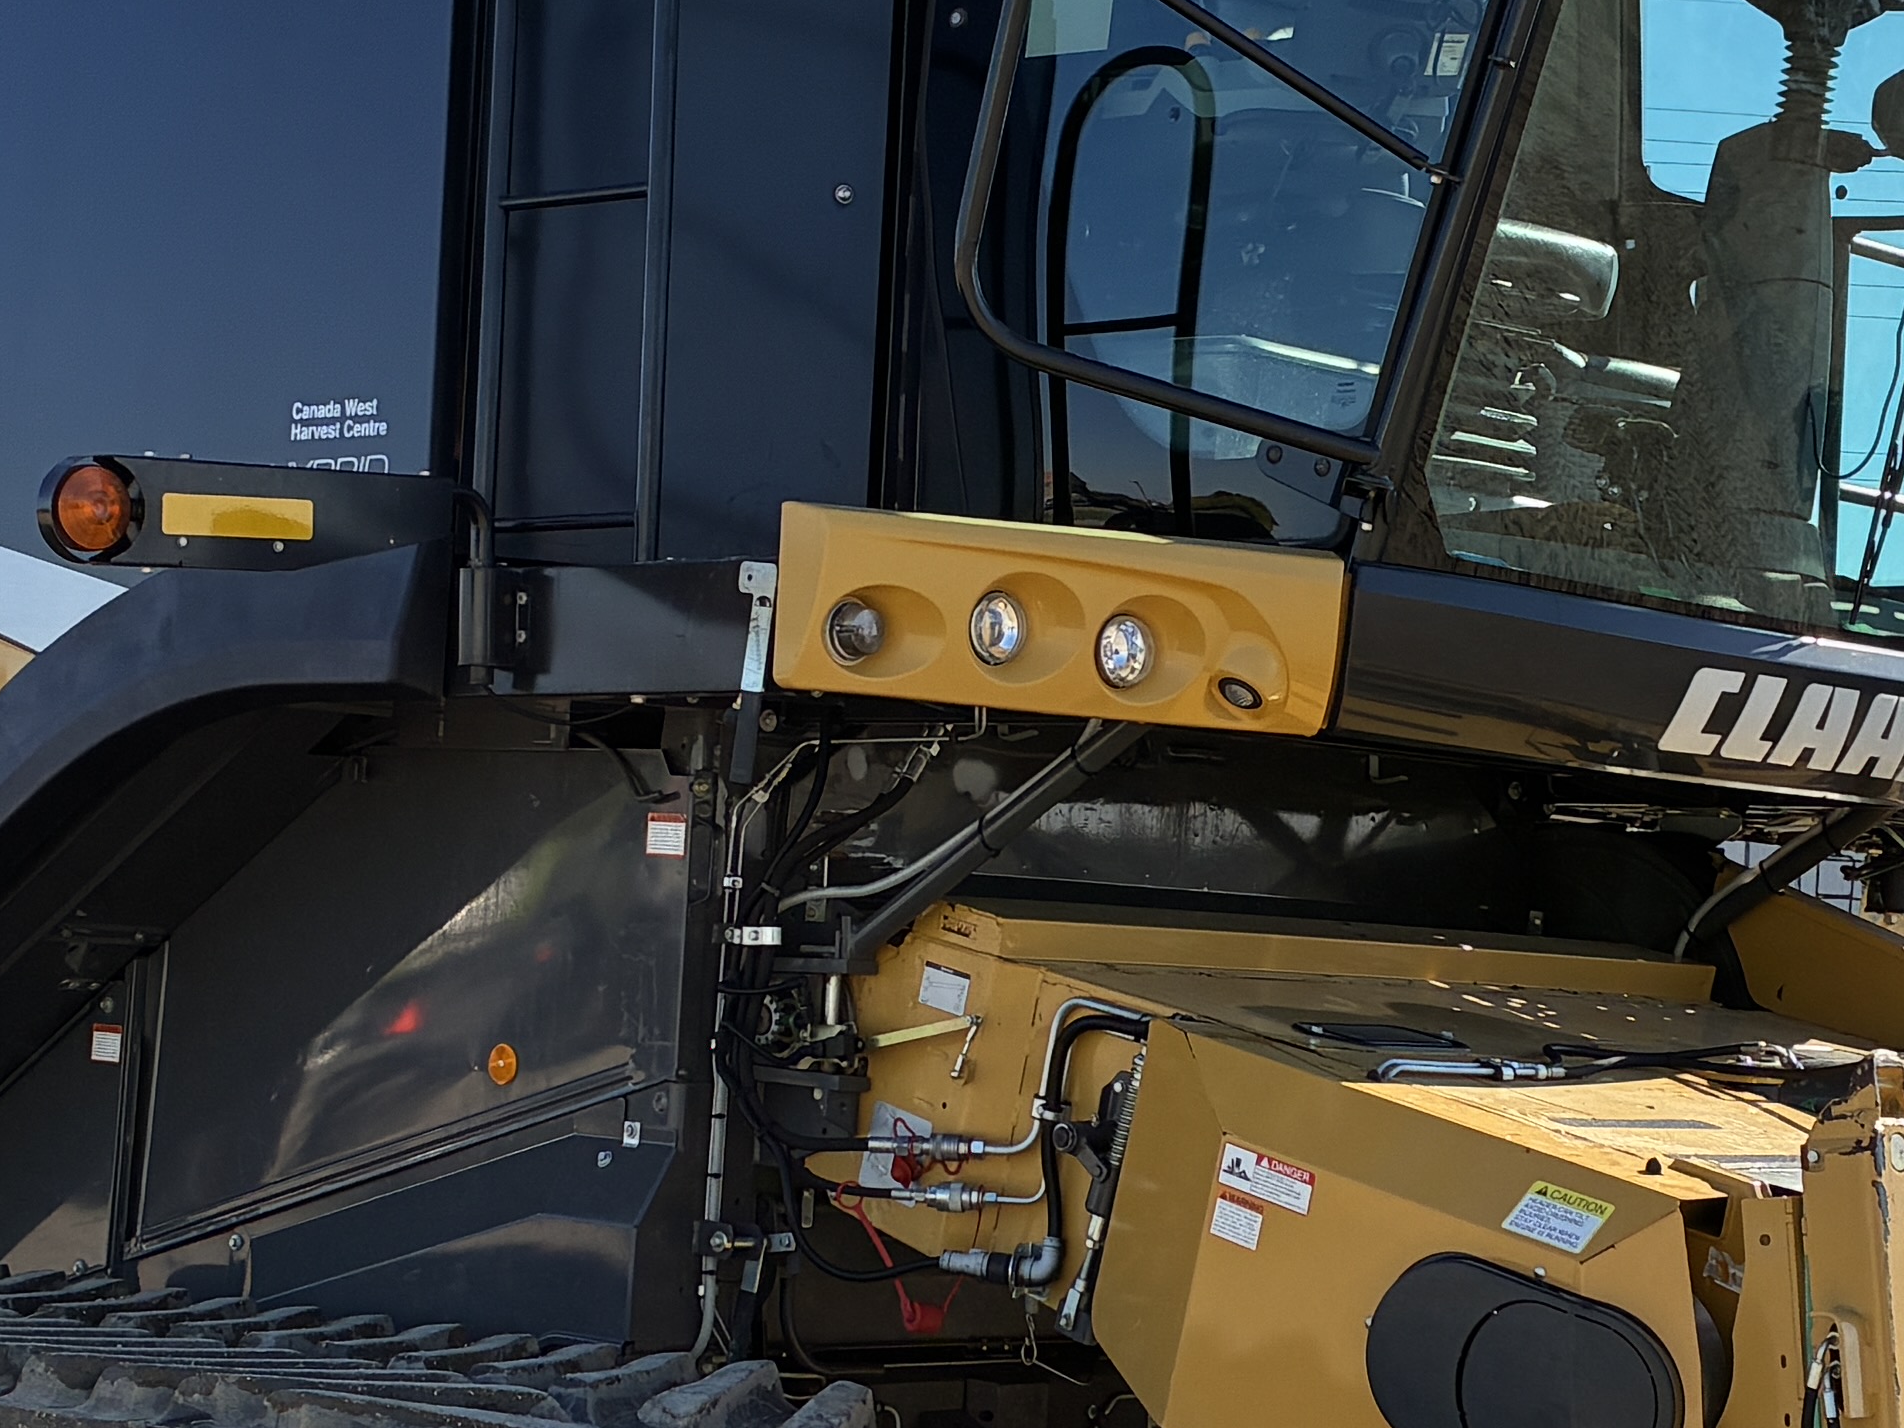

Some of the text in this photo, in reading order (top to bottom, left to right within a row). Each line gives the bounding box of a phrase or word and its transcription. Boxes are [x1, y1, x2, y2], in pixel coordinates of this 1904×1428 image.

[292, 398, 377, 420] Canada West
[290, 419, 388, 441] Harvest Centre
[1271, 1160, 1310, 1183] DANGER
[1549, 1189, 1608, 1216] CAUTION
